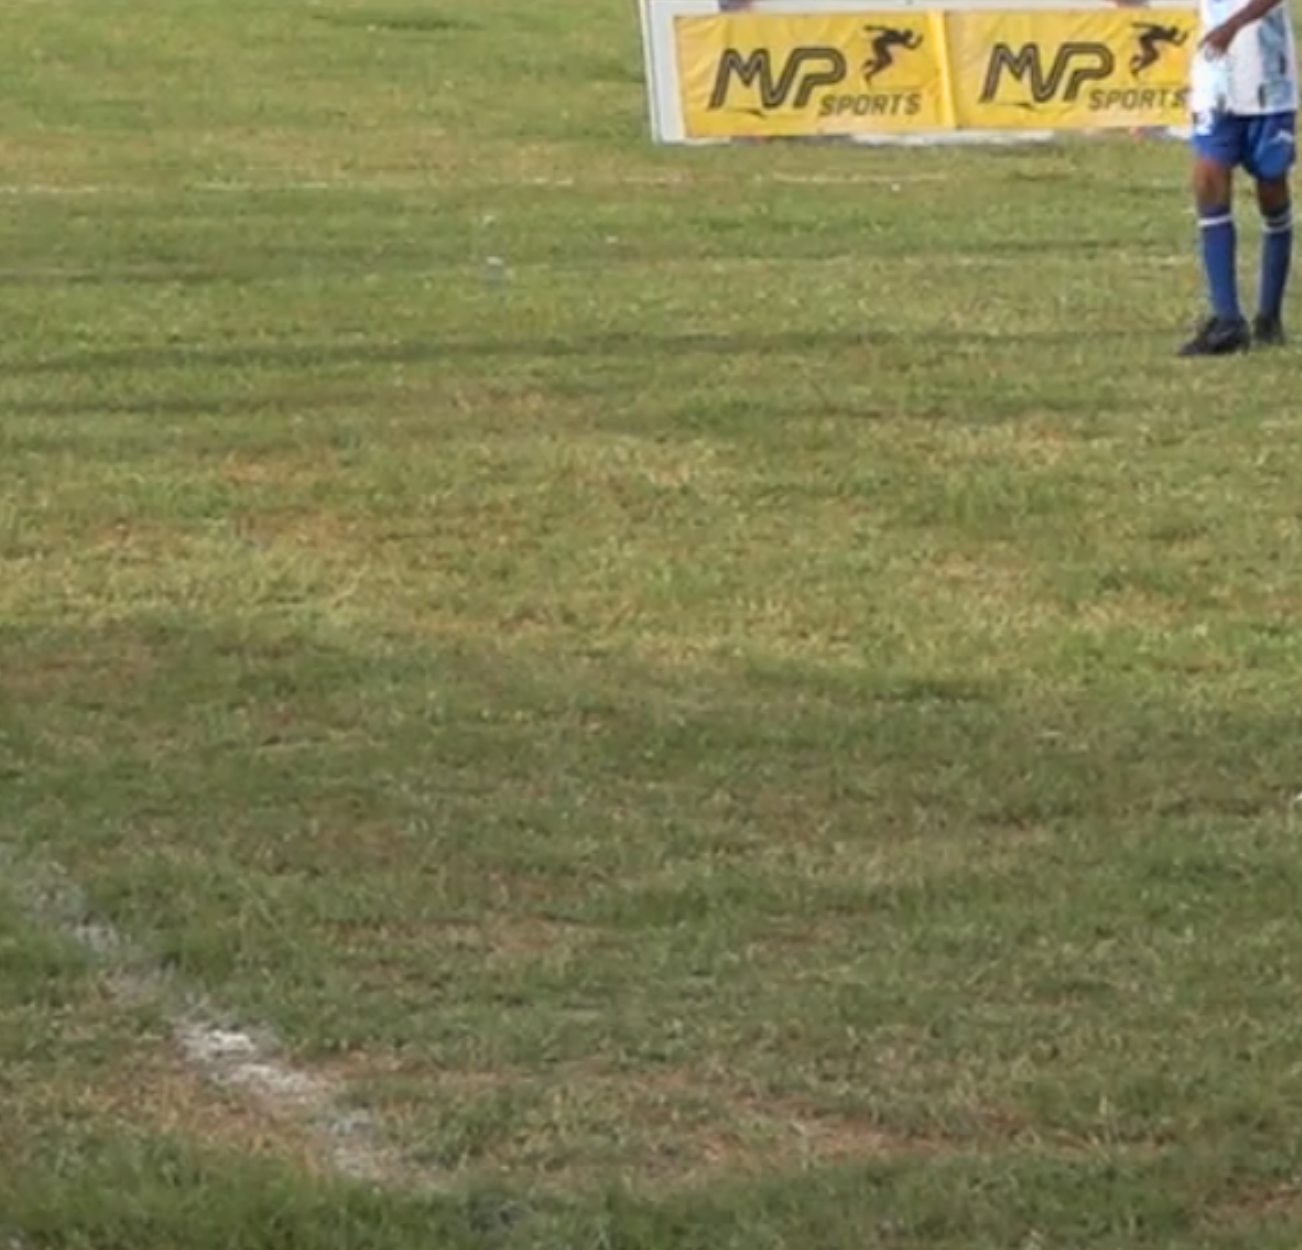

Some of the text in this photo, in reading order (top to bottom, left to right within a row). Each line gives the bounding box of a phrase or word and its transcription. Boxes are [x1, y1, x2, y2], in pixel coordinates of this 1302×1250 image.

[707, 46, 847, 110] MVP
[978, 41, 1115, 103] MVP
[817, 92, 922, 117] SPORTS
